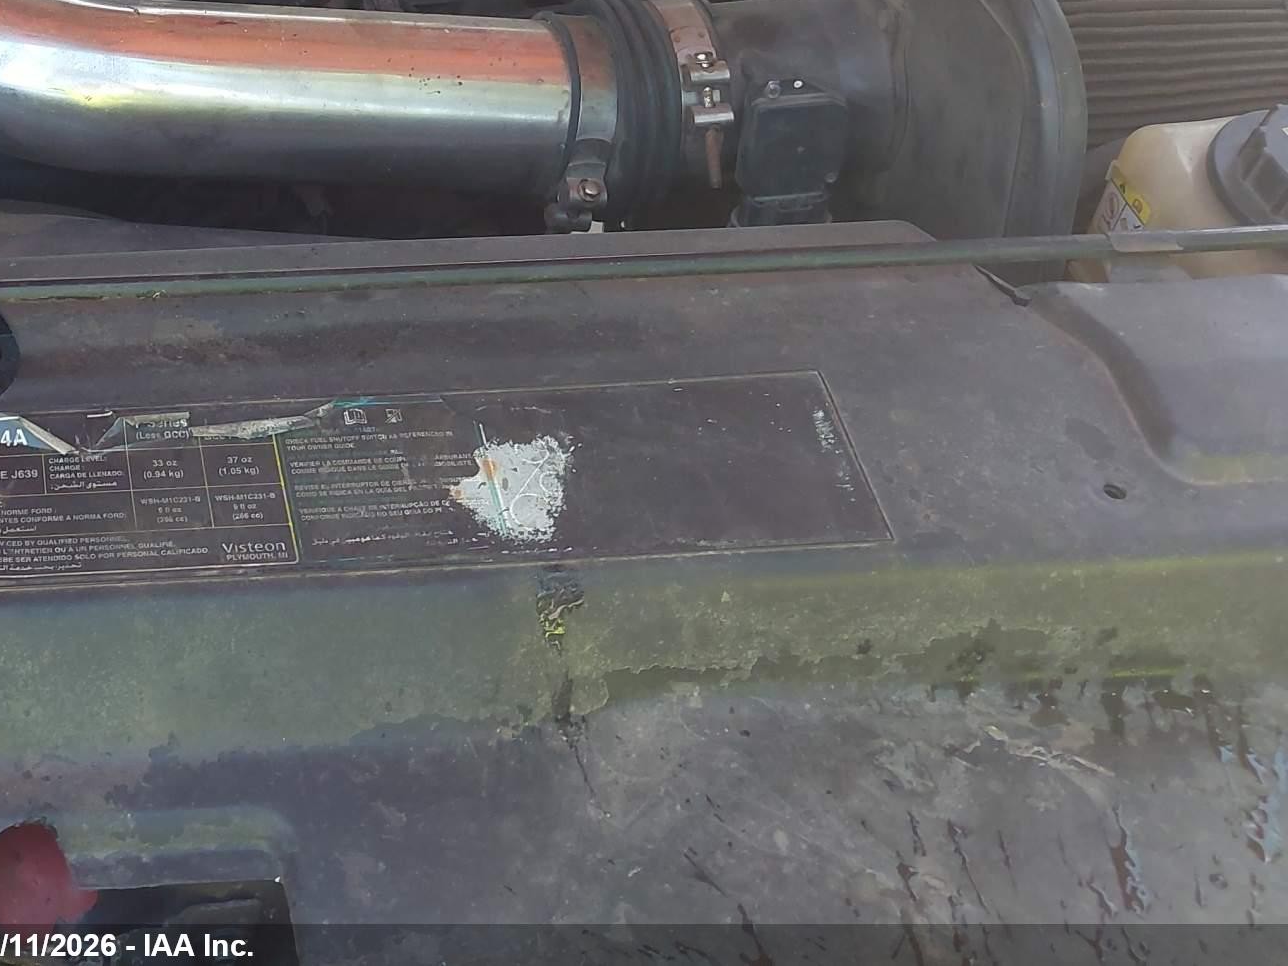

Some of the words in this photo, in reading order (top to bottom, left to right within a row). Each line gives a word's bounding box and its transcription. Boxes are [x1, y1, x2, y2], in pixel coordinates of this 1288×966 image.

[48, 457, 80, 465] CHARGE
[152, 459, 165, 467] 33
[226, 456, 239, 465] 37
[240, 455, 254, 464] oz
[11, 470, 39, 481] J639
[143, 469, 167, 480] (0.94
[168, 469, 184, 480] kg)
[218, 467, 242, 478] (1.05
[243, 465, 260, 476] kg)
[222, 540, 287, 555] Visteon
[15, 554, 33, 563] SER
